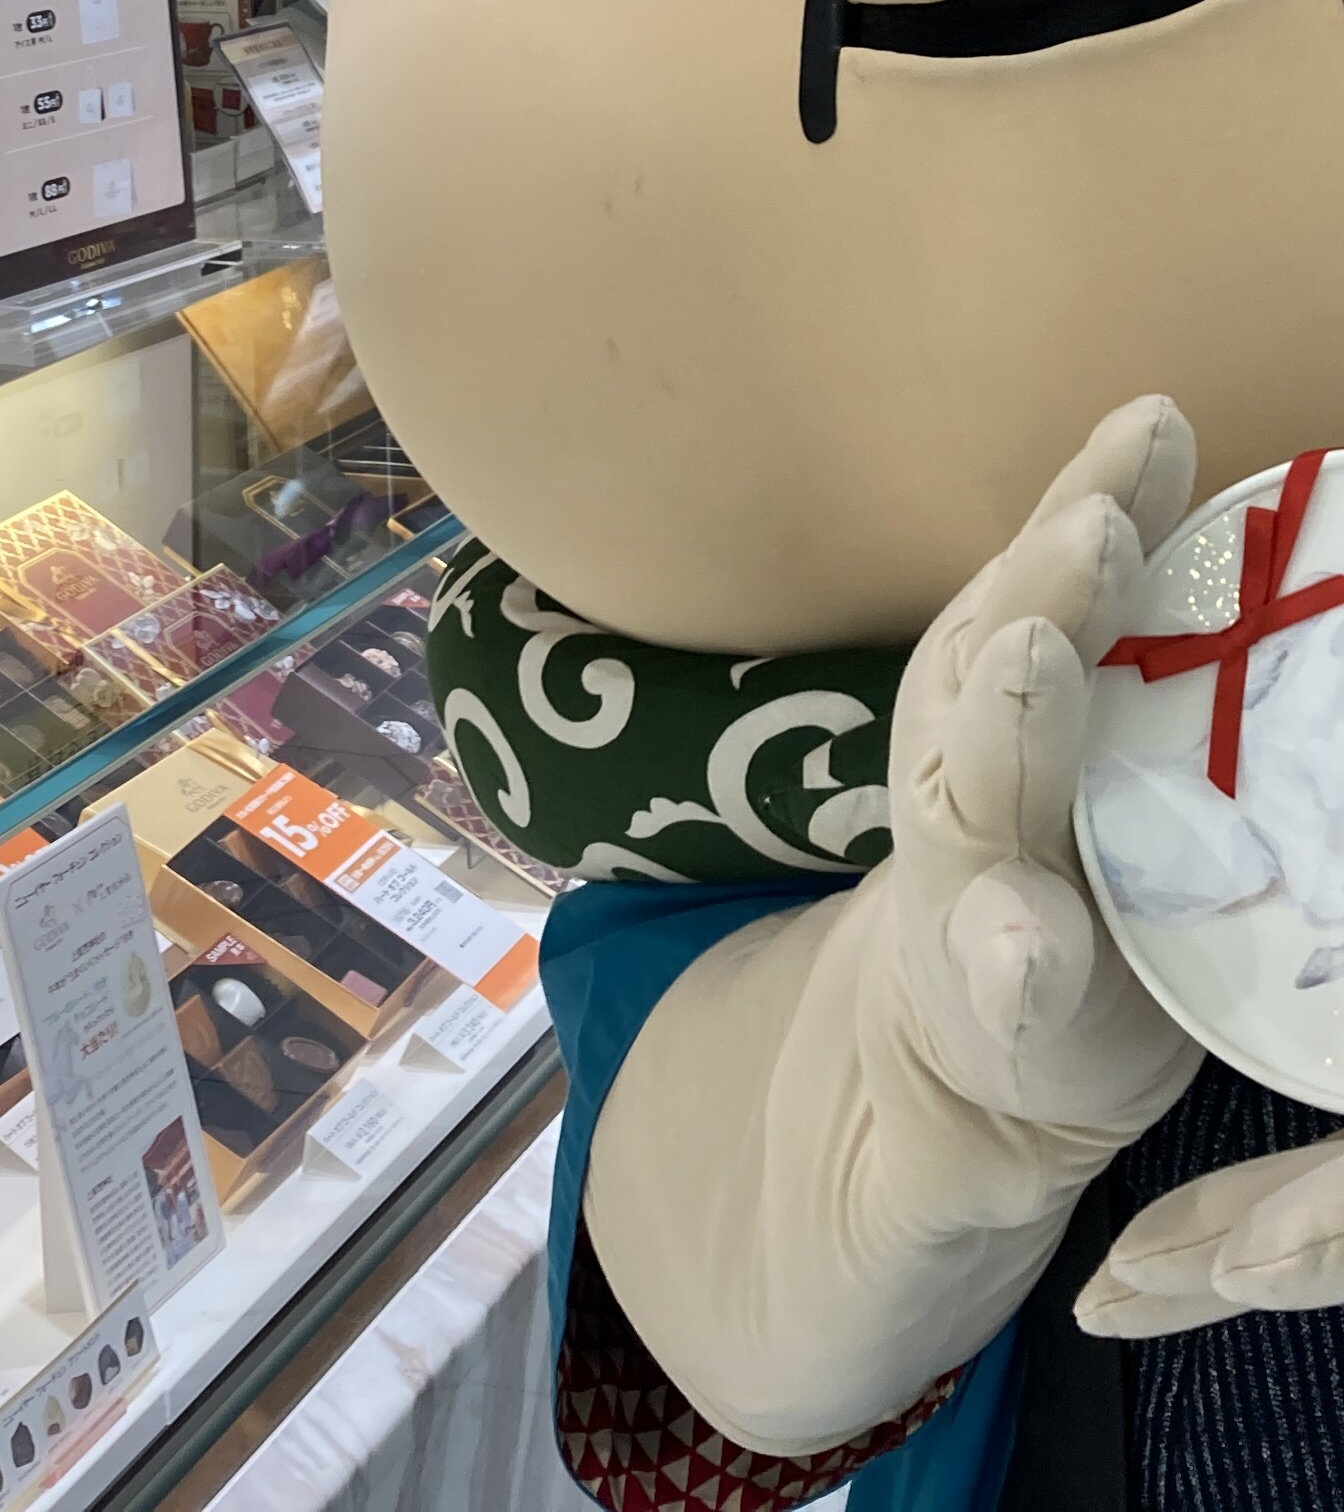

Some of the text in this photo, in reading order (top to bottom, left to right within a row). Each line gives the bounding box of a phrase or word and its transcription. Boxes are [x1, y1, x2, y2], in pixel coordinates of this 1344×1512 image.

[68, 240, 118, 265] GODIVA
[55, 575, 100, 601] GODIVA
[185, 784, 230, 813] GODIVA
[258, 802, 351, 858] 15%OFF
